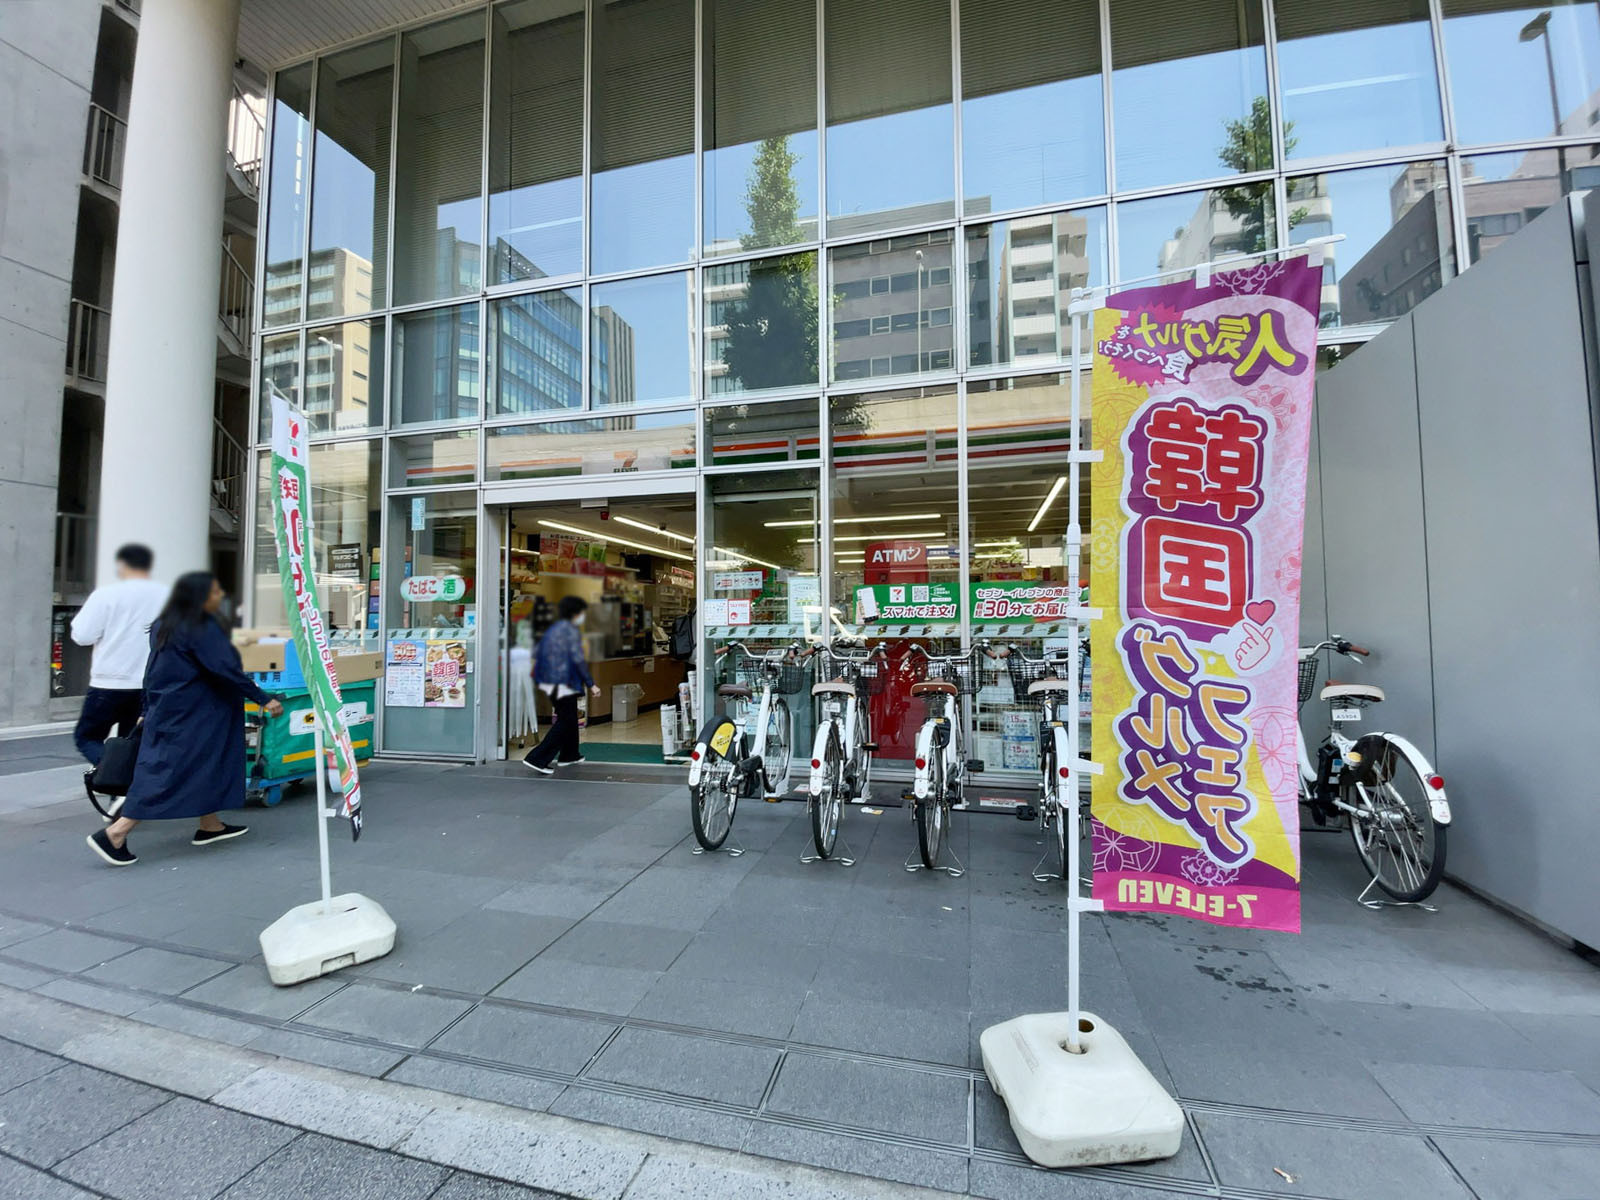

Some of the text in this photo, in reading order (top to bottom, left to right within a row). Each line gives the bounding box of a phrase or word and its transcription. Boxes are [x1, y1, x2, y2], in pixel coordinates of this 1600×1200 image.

[872, 549, 908, 563] ATM
[408, 578, 457, 594] たばこ 酒
[977, 588, 1080, 598] セブン-イレブンの商品
[882, 604, 957, 618] スマホで注文!
